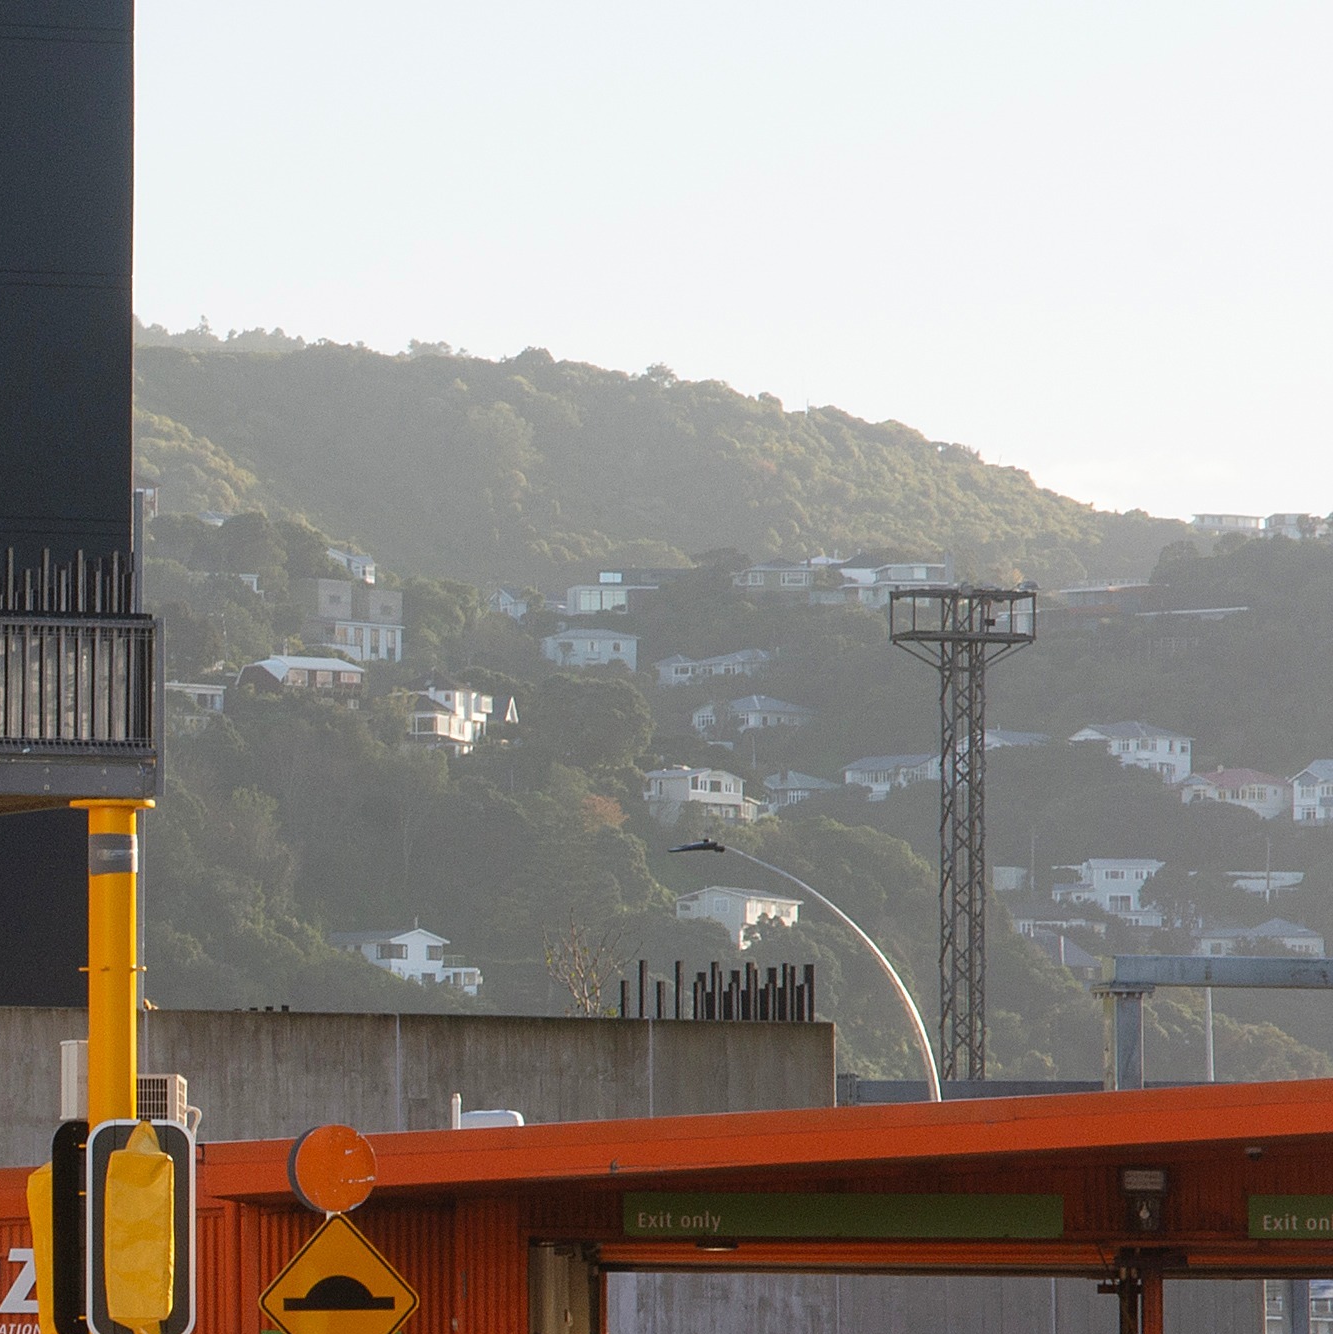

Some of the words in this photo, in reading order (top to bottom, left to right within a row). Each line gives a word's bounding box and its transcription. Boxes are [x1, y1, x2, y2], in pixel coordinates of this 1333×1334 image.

[637, 1211, 672, 1229] Exit
[680, 1210, 721, 1233] only
[1263, 1213, 1298, 1231] Exit
[1306, 1213, 1333, 1231] on
